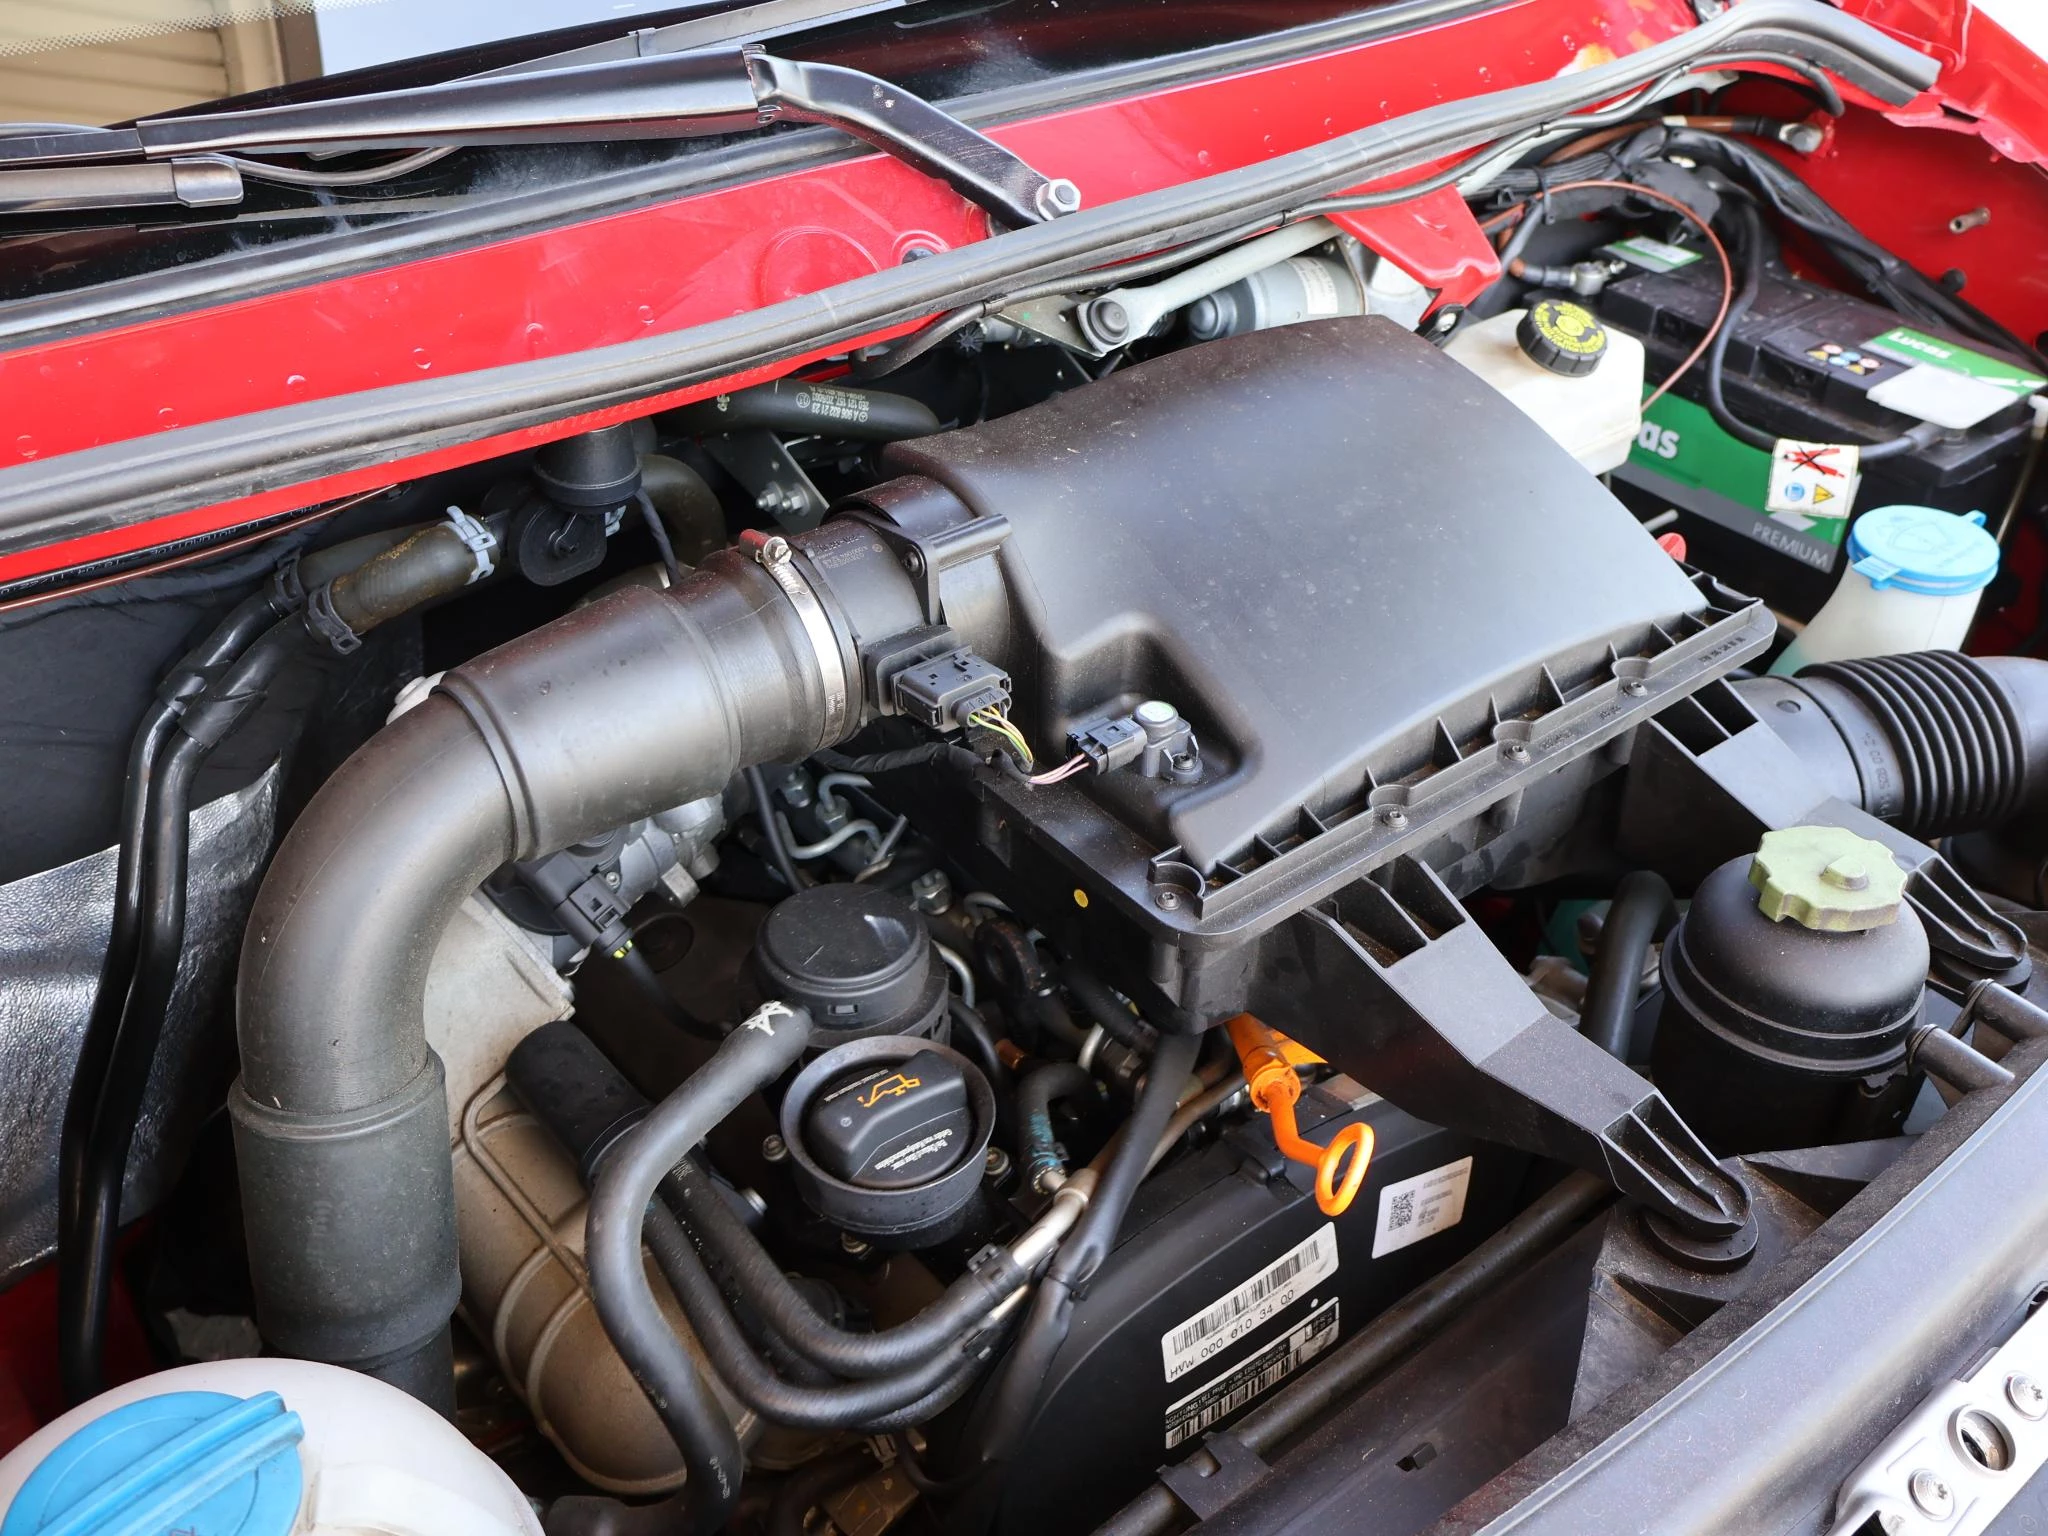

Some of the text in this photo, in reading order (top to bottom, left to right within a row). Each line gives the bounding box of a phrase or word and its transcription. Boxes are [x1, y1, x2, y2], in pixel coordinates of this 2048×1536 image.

[1752, 521, 1829, 568] PREMIUM
[1169, 1357, 1195, 1380] HVW
[1200, 1338, 1224, 1358] 000
[1259, 1305, 1274, 1321] 34
[1280, 1289, 1295, 1306] 00
